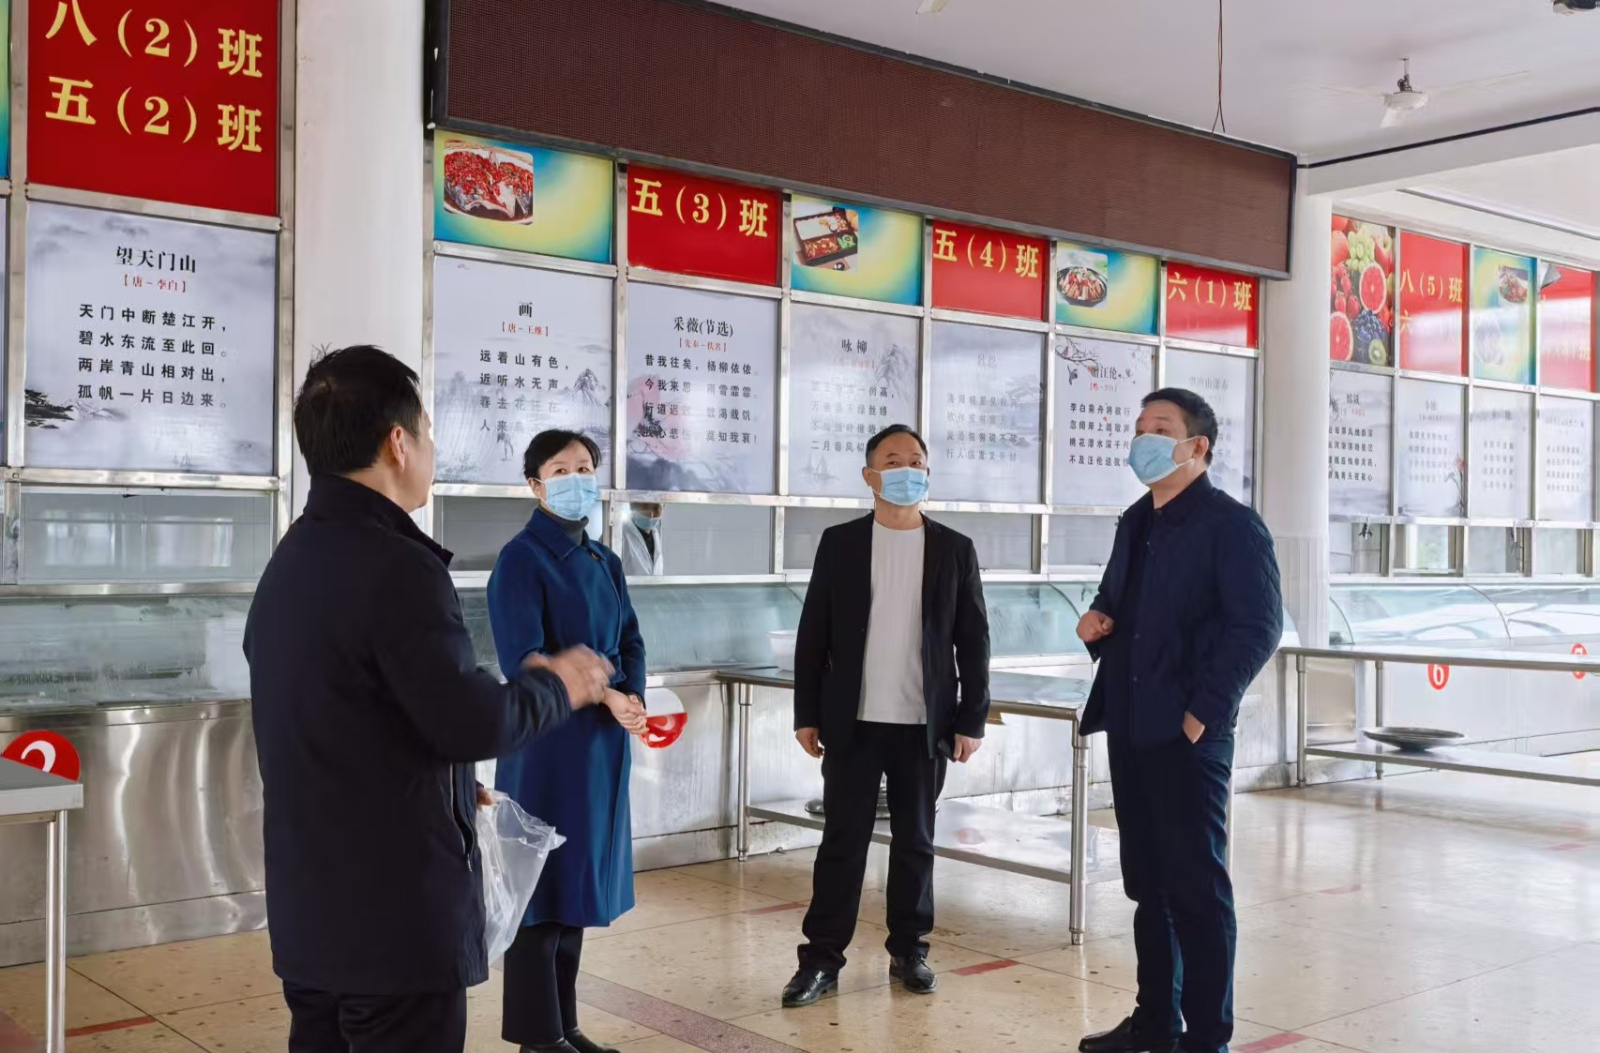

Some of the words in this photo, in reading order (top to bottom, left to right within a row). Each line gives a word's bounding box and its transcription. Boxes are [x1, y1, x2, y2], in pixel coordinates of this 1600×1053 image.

[45, 0, 263, 78] 八（2）班
[45, 76, 263, 153] 五（2）班
[631, 177, 768, 238] 五（3）班
[115, 246, 196, 273] 望天门山
[932, 228, 1039, 279] 五（4）班
[1168, 271, 1253, 311] 六（1）班
[1399, 269, 1463, 303] 八（5）班
[79, 303, 227, 332] 天门中断楚江开，
[518, 302, 533, 318] 画
[78, 330, 227, 358] 碧水东流至此回。
[841, 338, 868, 354] 咏柳
[77, 357, 226, 383] 两岸青山相对出，
[479, 350, 569, 370] 远看山有色，
[77, 384, 226, 408] 孤帆一片日边来。
